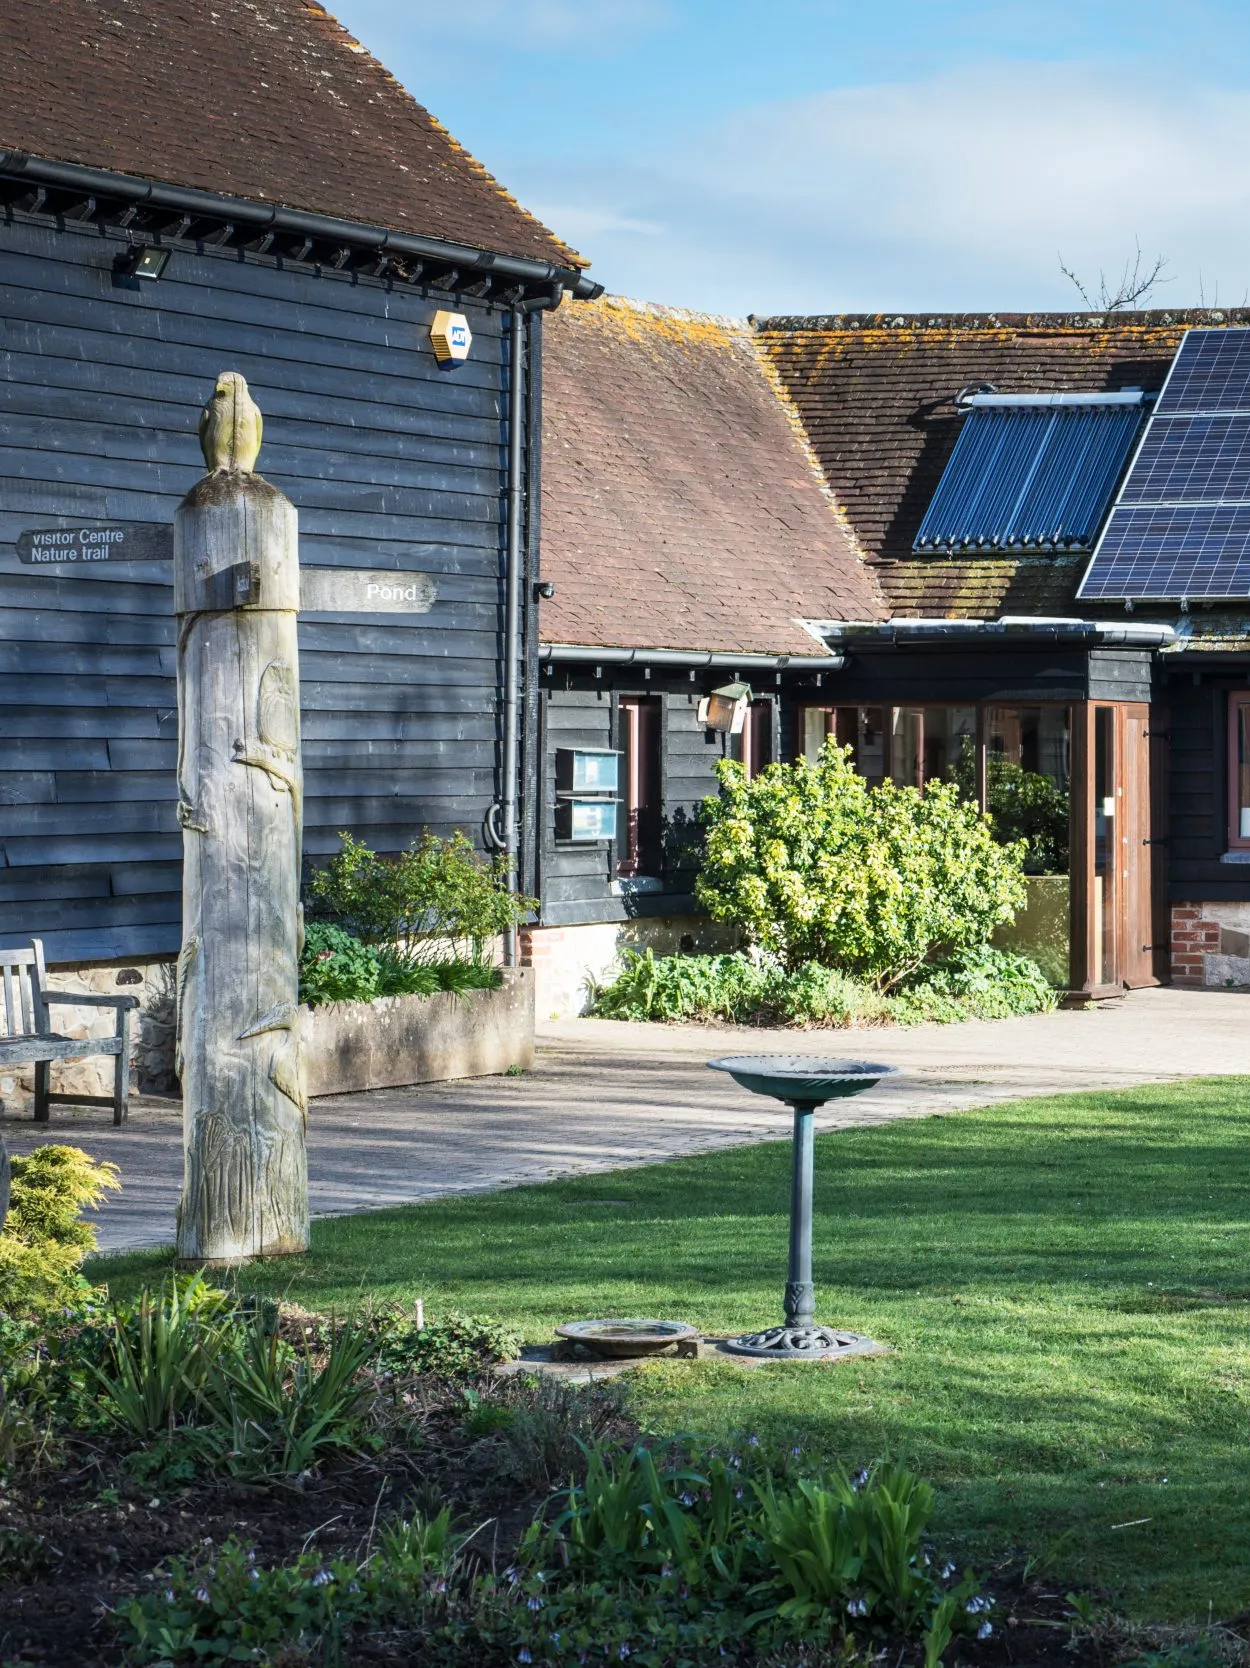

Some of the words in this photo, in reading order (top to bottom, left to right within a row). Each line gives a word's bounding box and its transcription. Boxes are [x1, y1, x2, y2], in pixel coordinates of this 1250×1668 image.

[79, 529, 124, 544] Centre
[31, 547, 77, 562] Nature
[82, 545, 109, 560] trail
[367, 583, 417, 601] Pond
